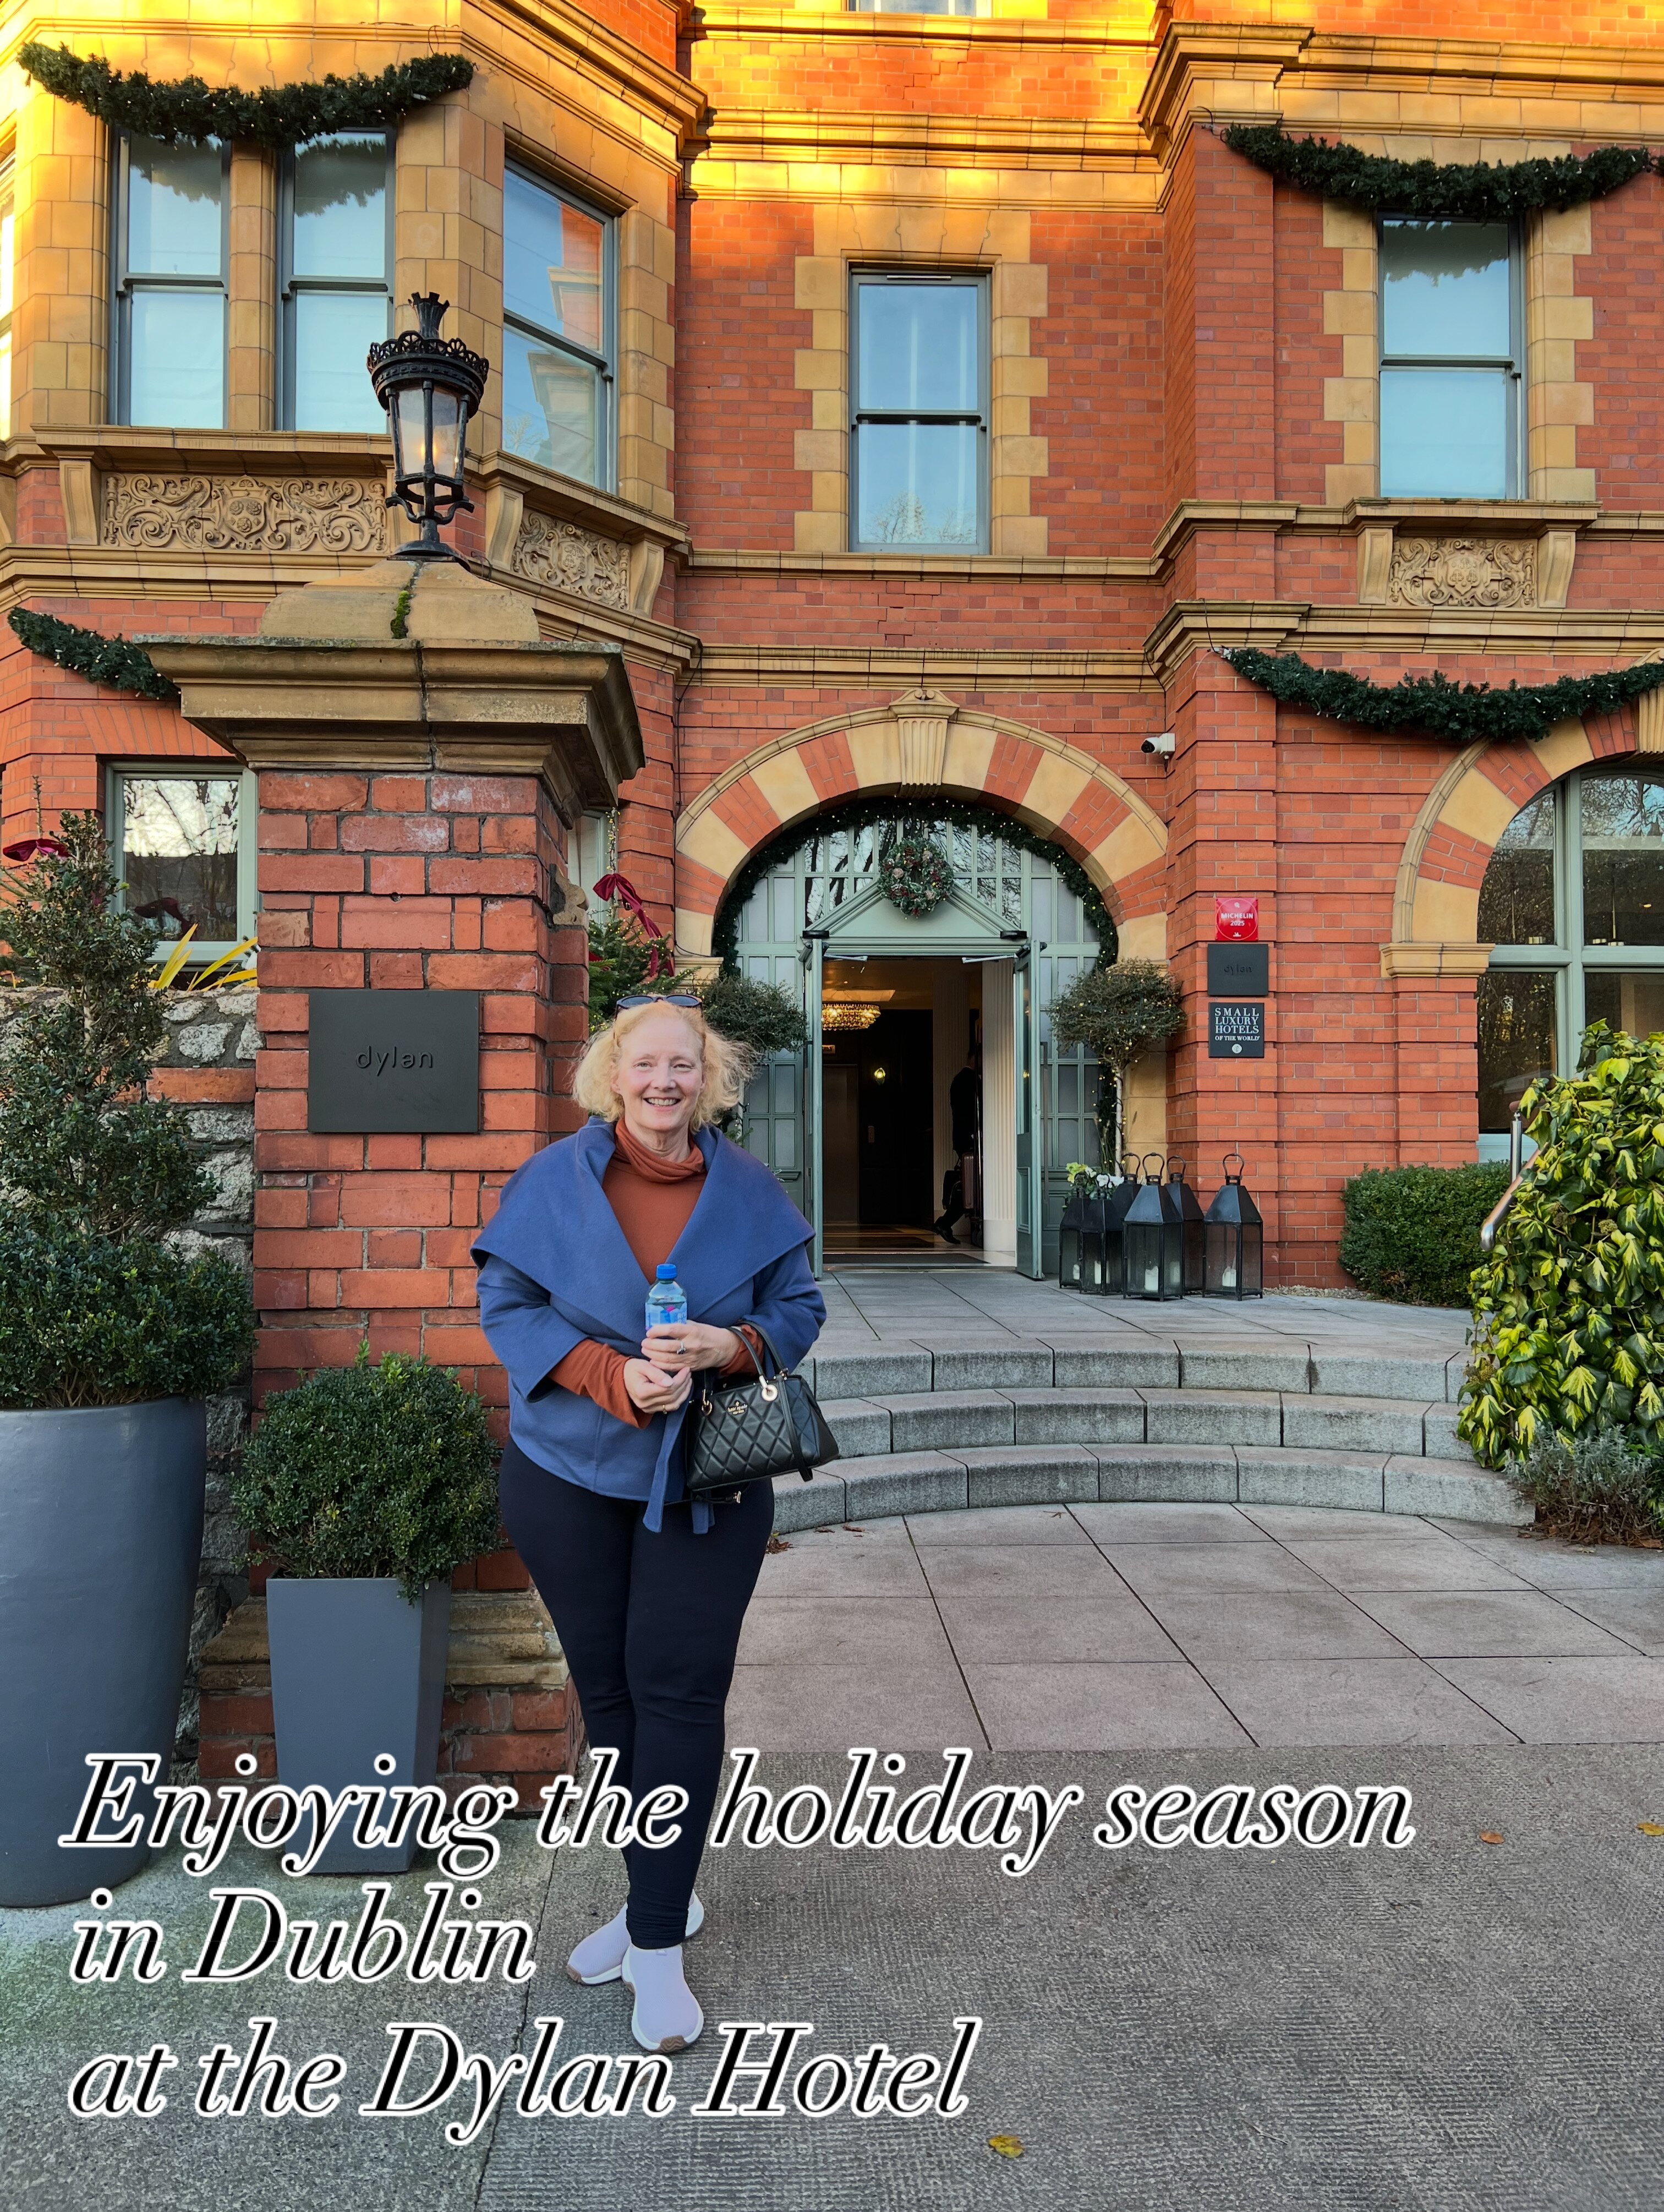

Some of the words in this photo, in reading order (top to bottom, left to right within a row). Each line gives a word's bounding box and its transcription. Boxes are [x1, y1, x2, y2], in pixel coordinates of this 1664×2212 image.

[1224, 964, 1252, 976] dylan
[1214, 1007, 1260, 1017] SMALL
[1214, 1016, 1259, 1025] LUXURY
[1215, 1025, 1260, 1034] HOTELS
[356, 1045, 434, 1077] dylan
